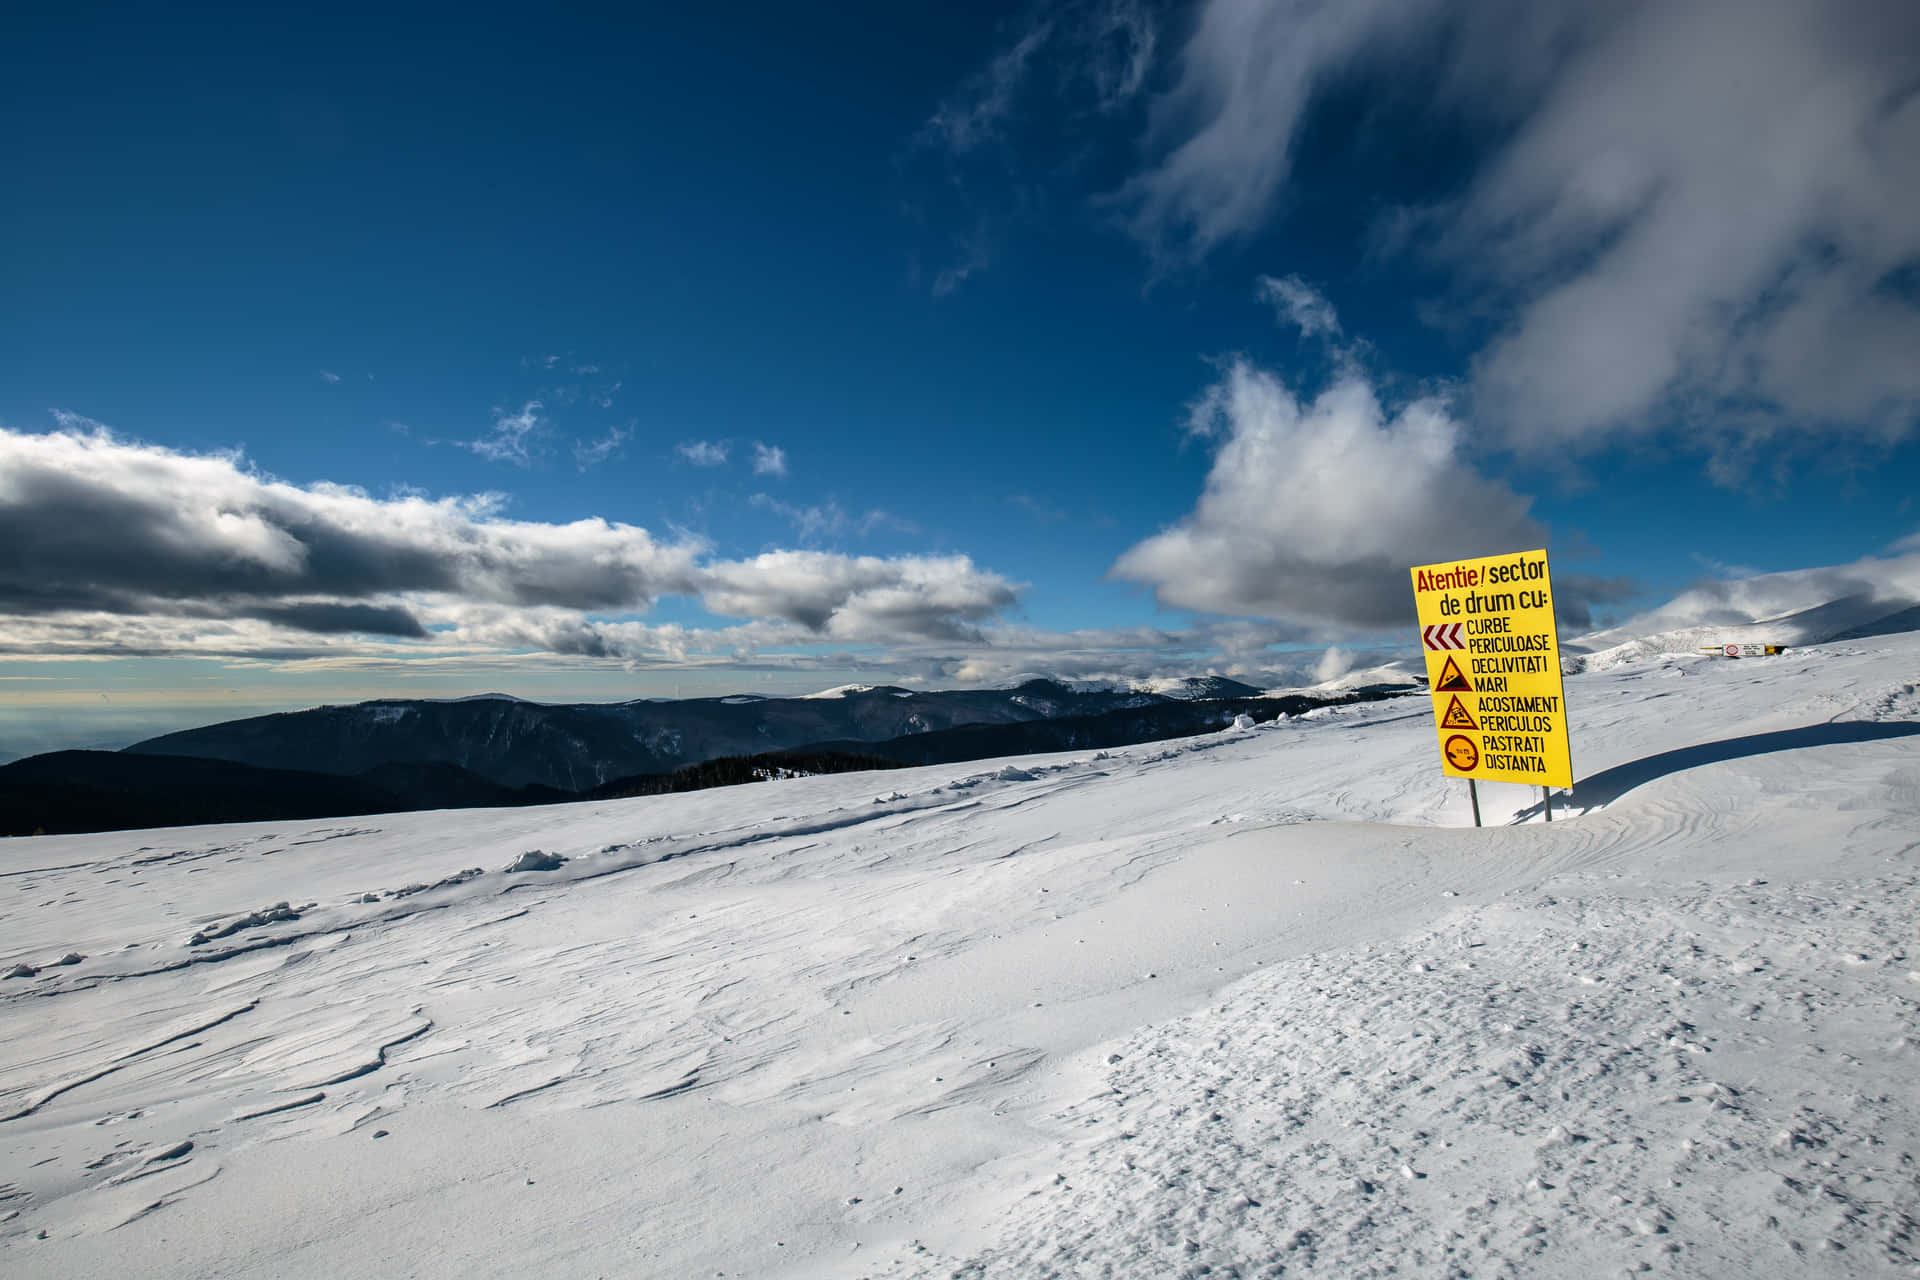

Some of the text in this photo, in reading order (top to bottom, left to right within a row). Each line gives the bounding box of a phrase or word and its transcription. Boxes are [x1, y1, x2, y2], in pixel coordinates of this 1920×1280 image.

[1489, 557, 1545, 584] sector
[1440, 590, 1548, 616] de drum cu:
[1467, 617, 1512, 635] CURBE
[1469, 634, 1551, 654] PERICULOASE
[1472, 656, 1547, 674] DECLIVITATI
[1474, 676, 1508, 692] MARI
[1478, 697, 1559, 713] ACOSTAMENT
[1480, 716, 1552, 732] PERICULOS
[1482, 736, 1545, 753] PASTRATI
[1485, 754, 1546, 773] DISTANTA
